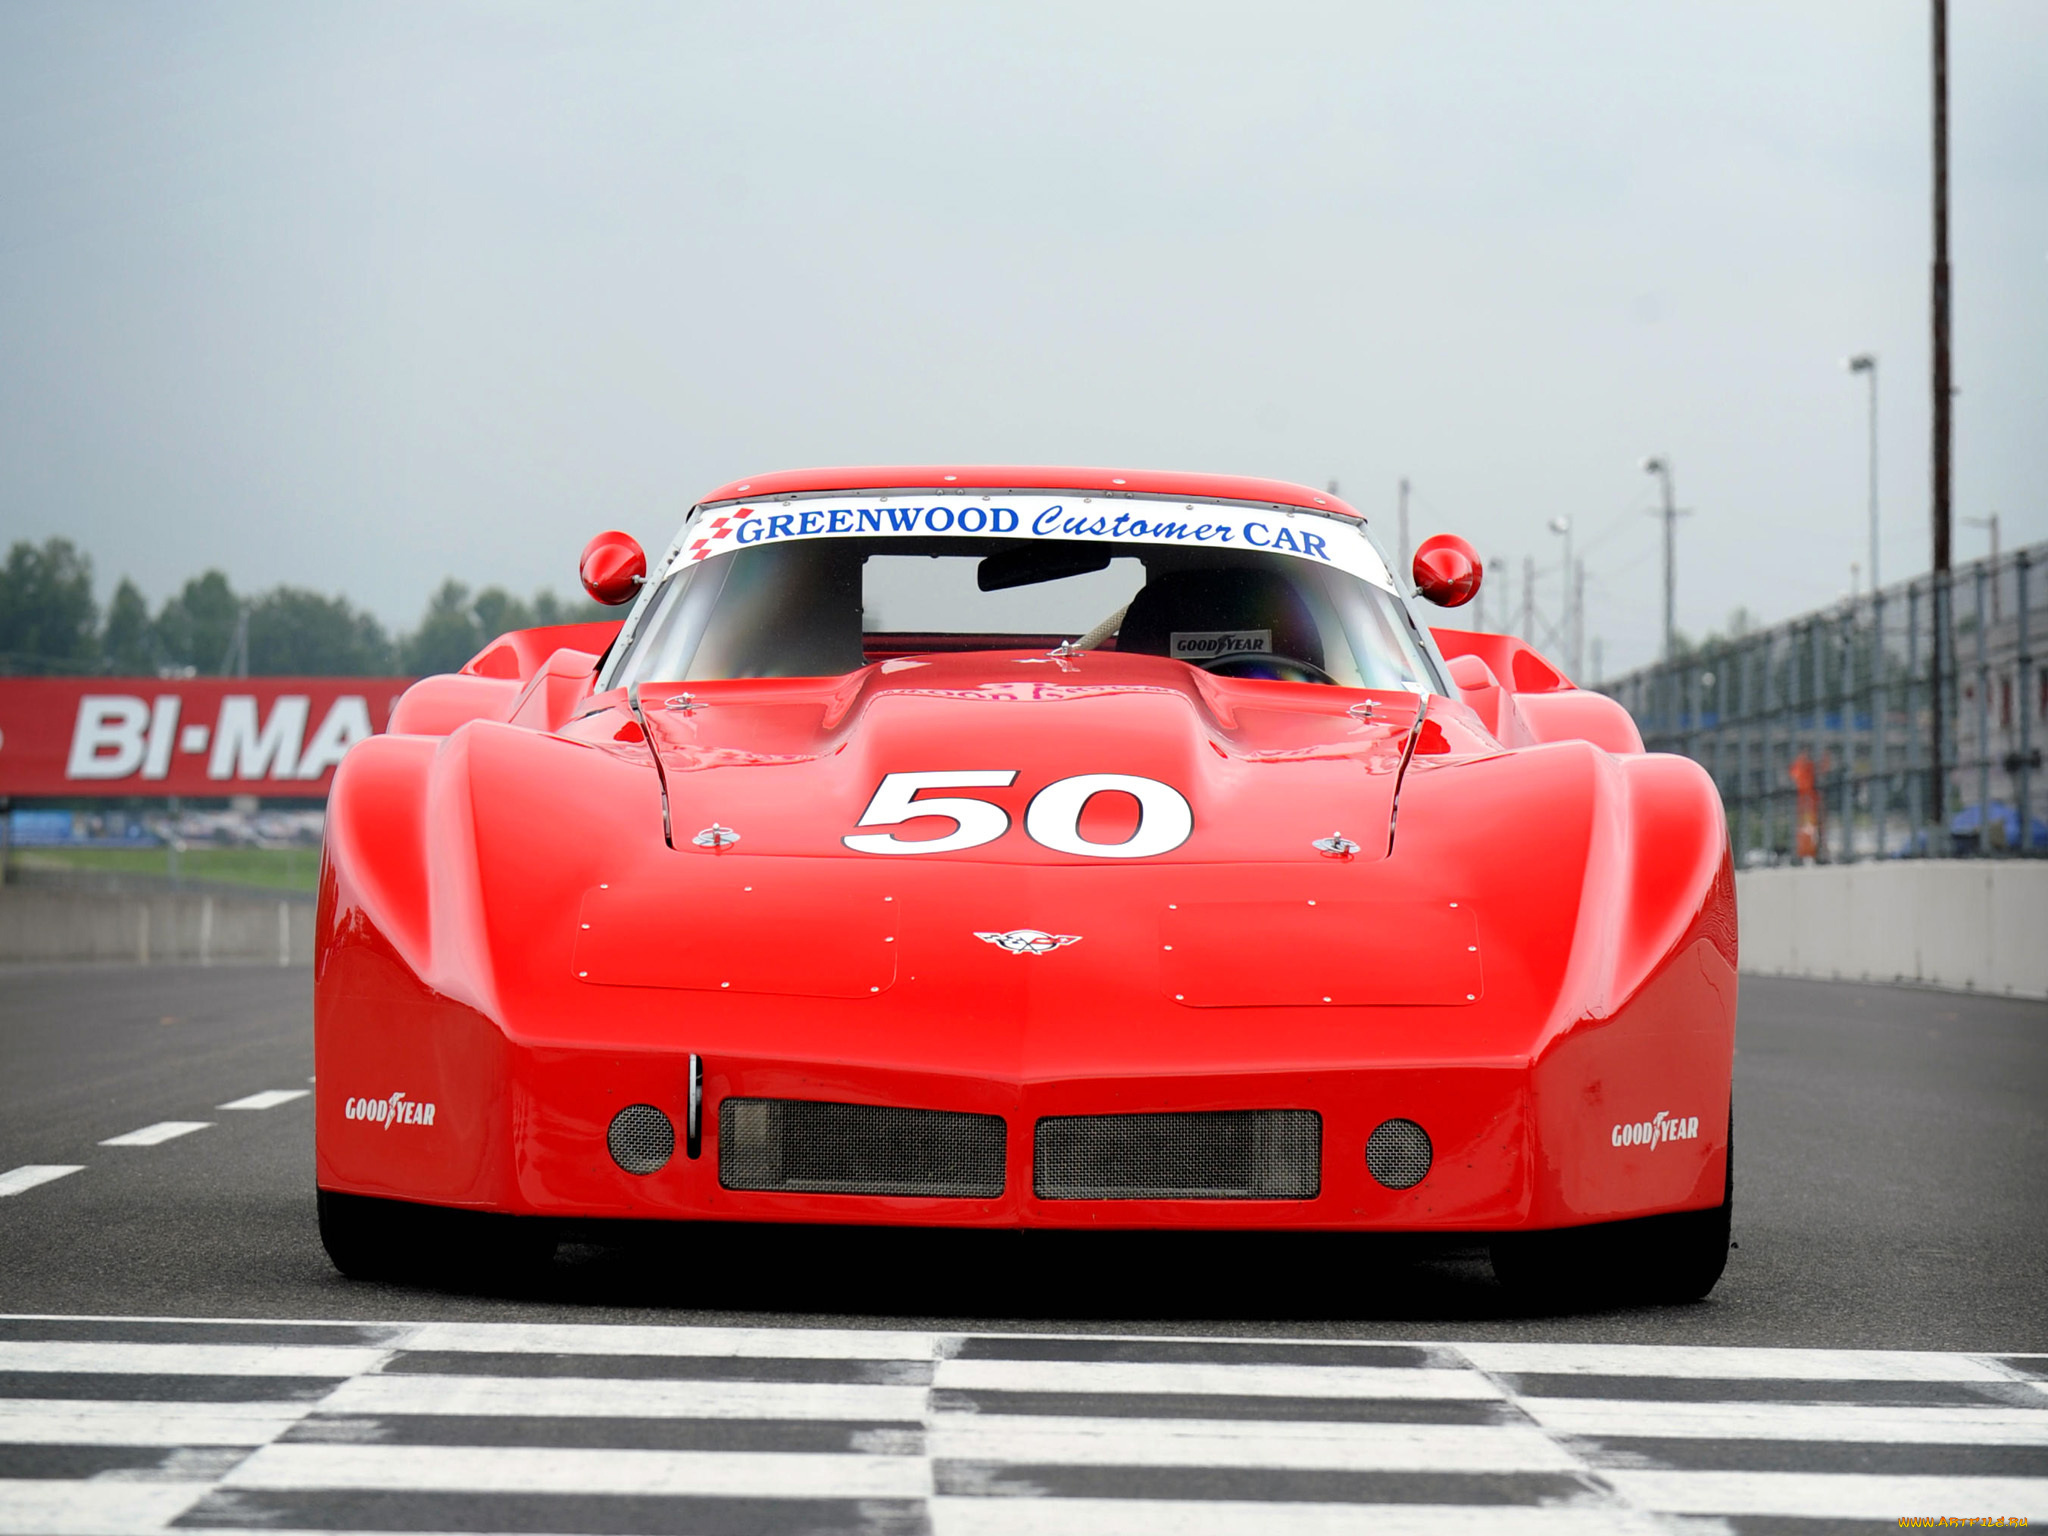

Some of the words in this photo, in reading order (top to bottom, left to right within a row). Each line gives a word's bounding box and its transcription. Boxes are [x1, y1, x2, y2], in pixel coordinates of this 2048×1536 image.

[736, 506, 1019, 544] GREENWOOD
[1032, 505, 1235, 543] Customer
[1243, 521, 1331, 562] CAR
[66, 694, 399, 780] BI-MA
[841, 770, 1195, 859] 50
